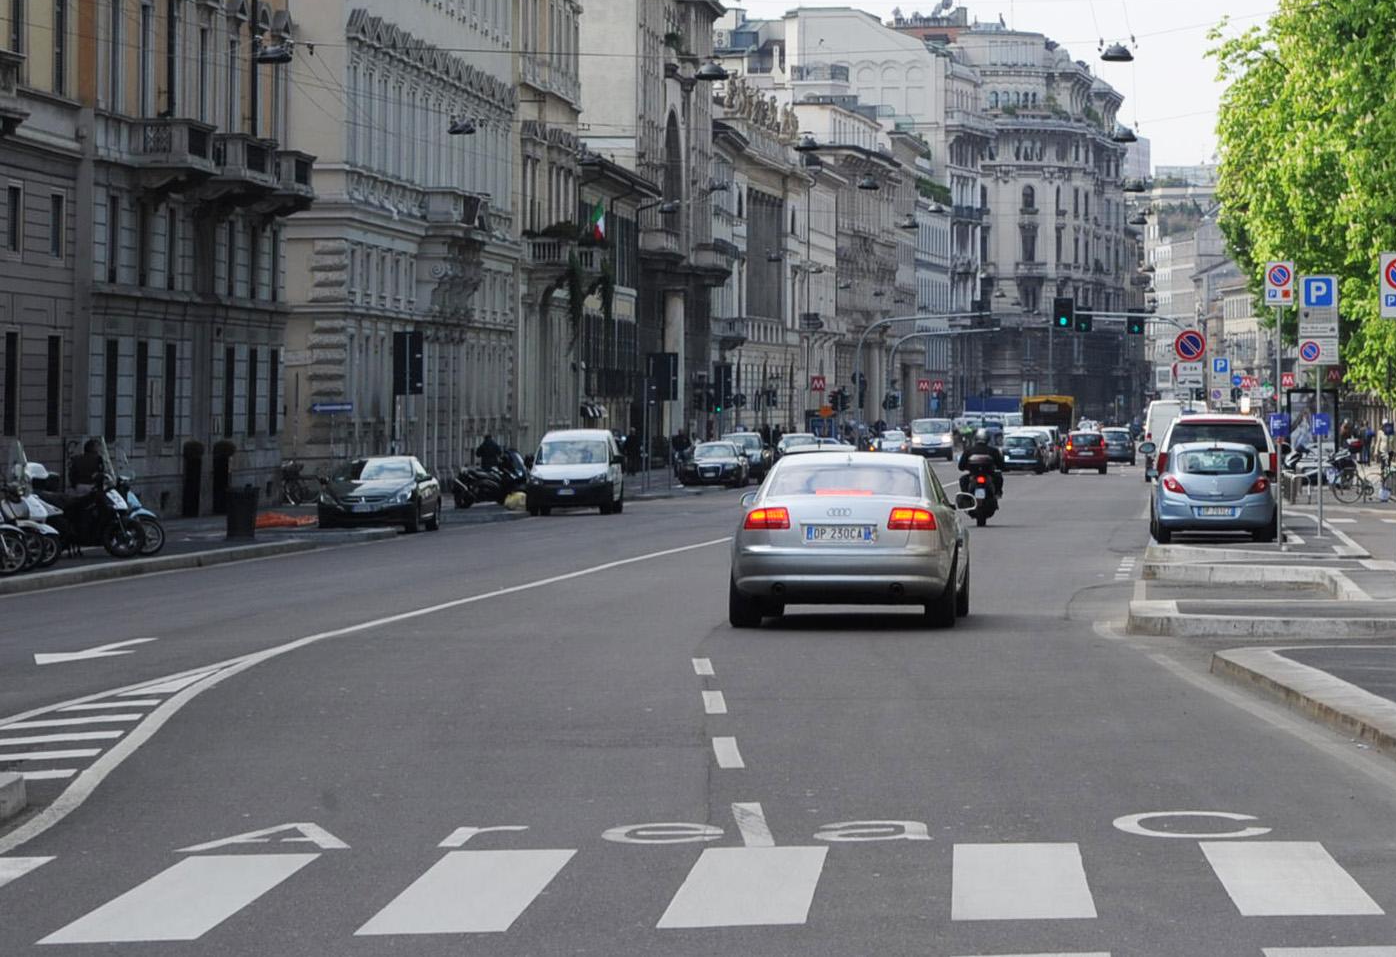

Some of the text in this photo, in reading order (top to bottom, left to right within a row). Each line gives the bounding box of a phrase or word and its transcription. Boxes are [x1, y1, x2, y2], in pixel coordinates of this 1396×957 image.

[1310, 281, 1327, 303] P
[1387, 294, 1396, 306] P
[1216, 358, 1226, 371] P
[813, 379, 824, 388] M
[1282, 375, 1294, 386] M
[1112, 810, 1273, 839] C
